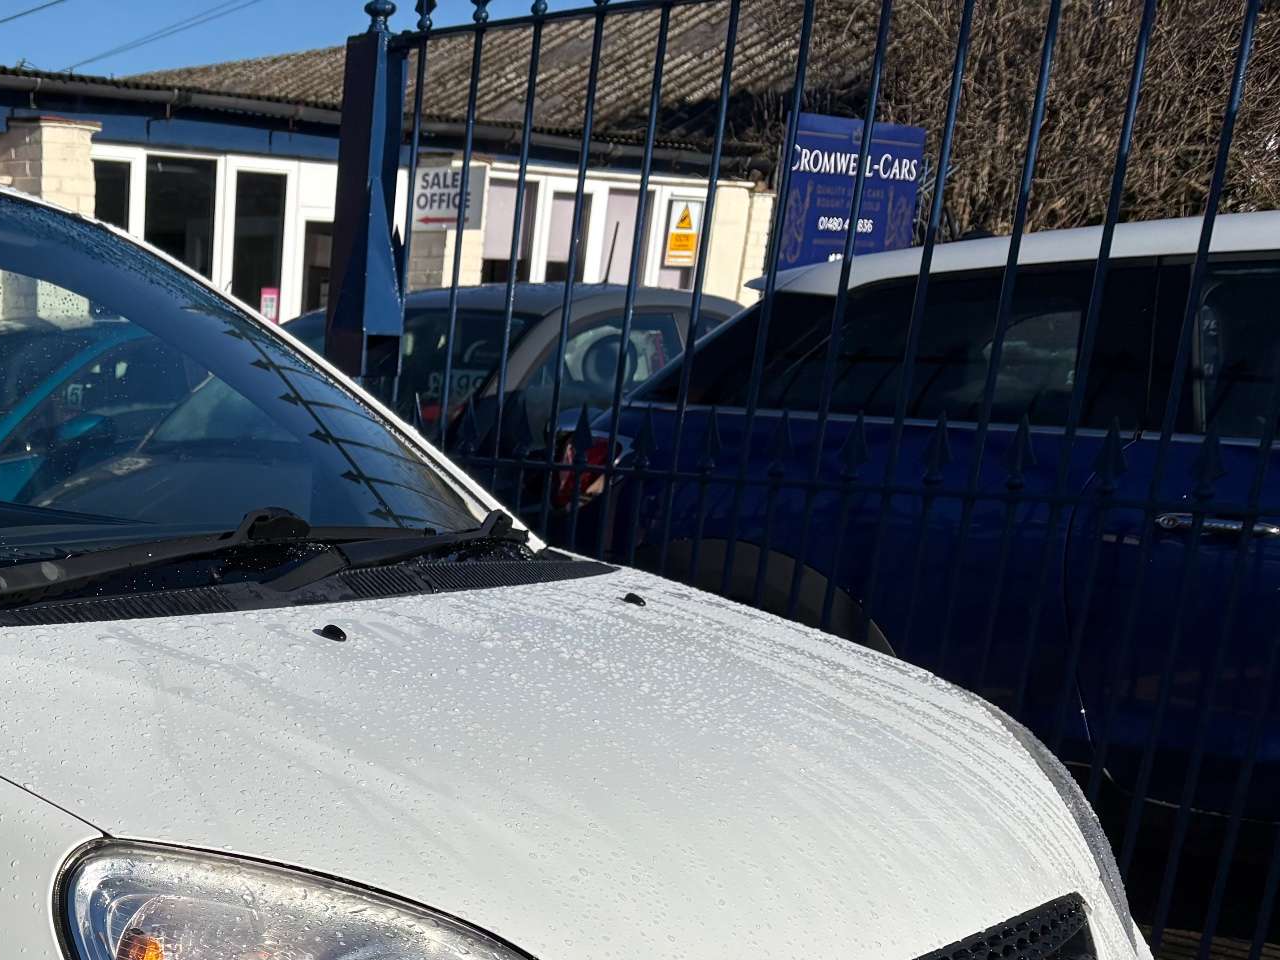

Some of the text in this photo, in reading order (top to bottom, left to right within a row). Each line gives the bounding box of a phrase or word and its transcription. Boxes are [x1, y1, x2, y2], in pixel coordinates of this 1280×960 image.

[791, 144, 918, 182] ROMWEL-CARS
[421, 172, 460, 190] SALE
[416, 192, 471, 210] OFFICE
[843, 217, 873, 233] 4836
